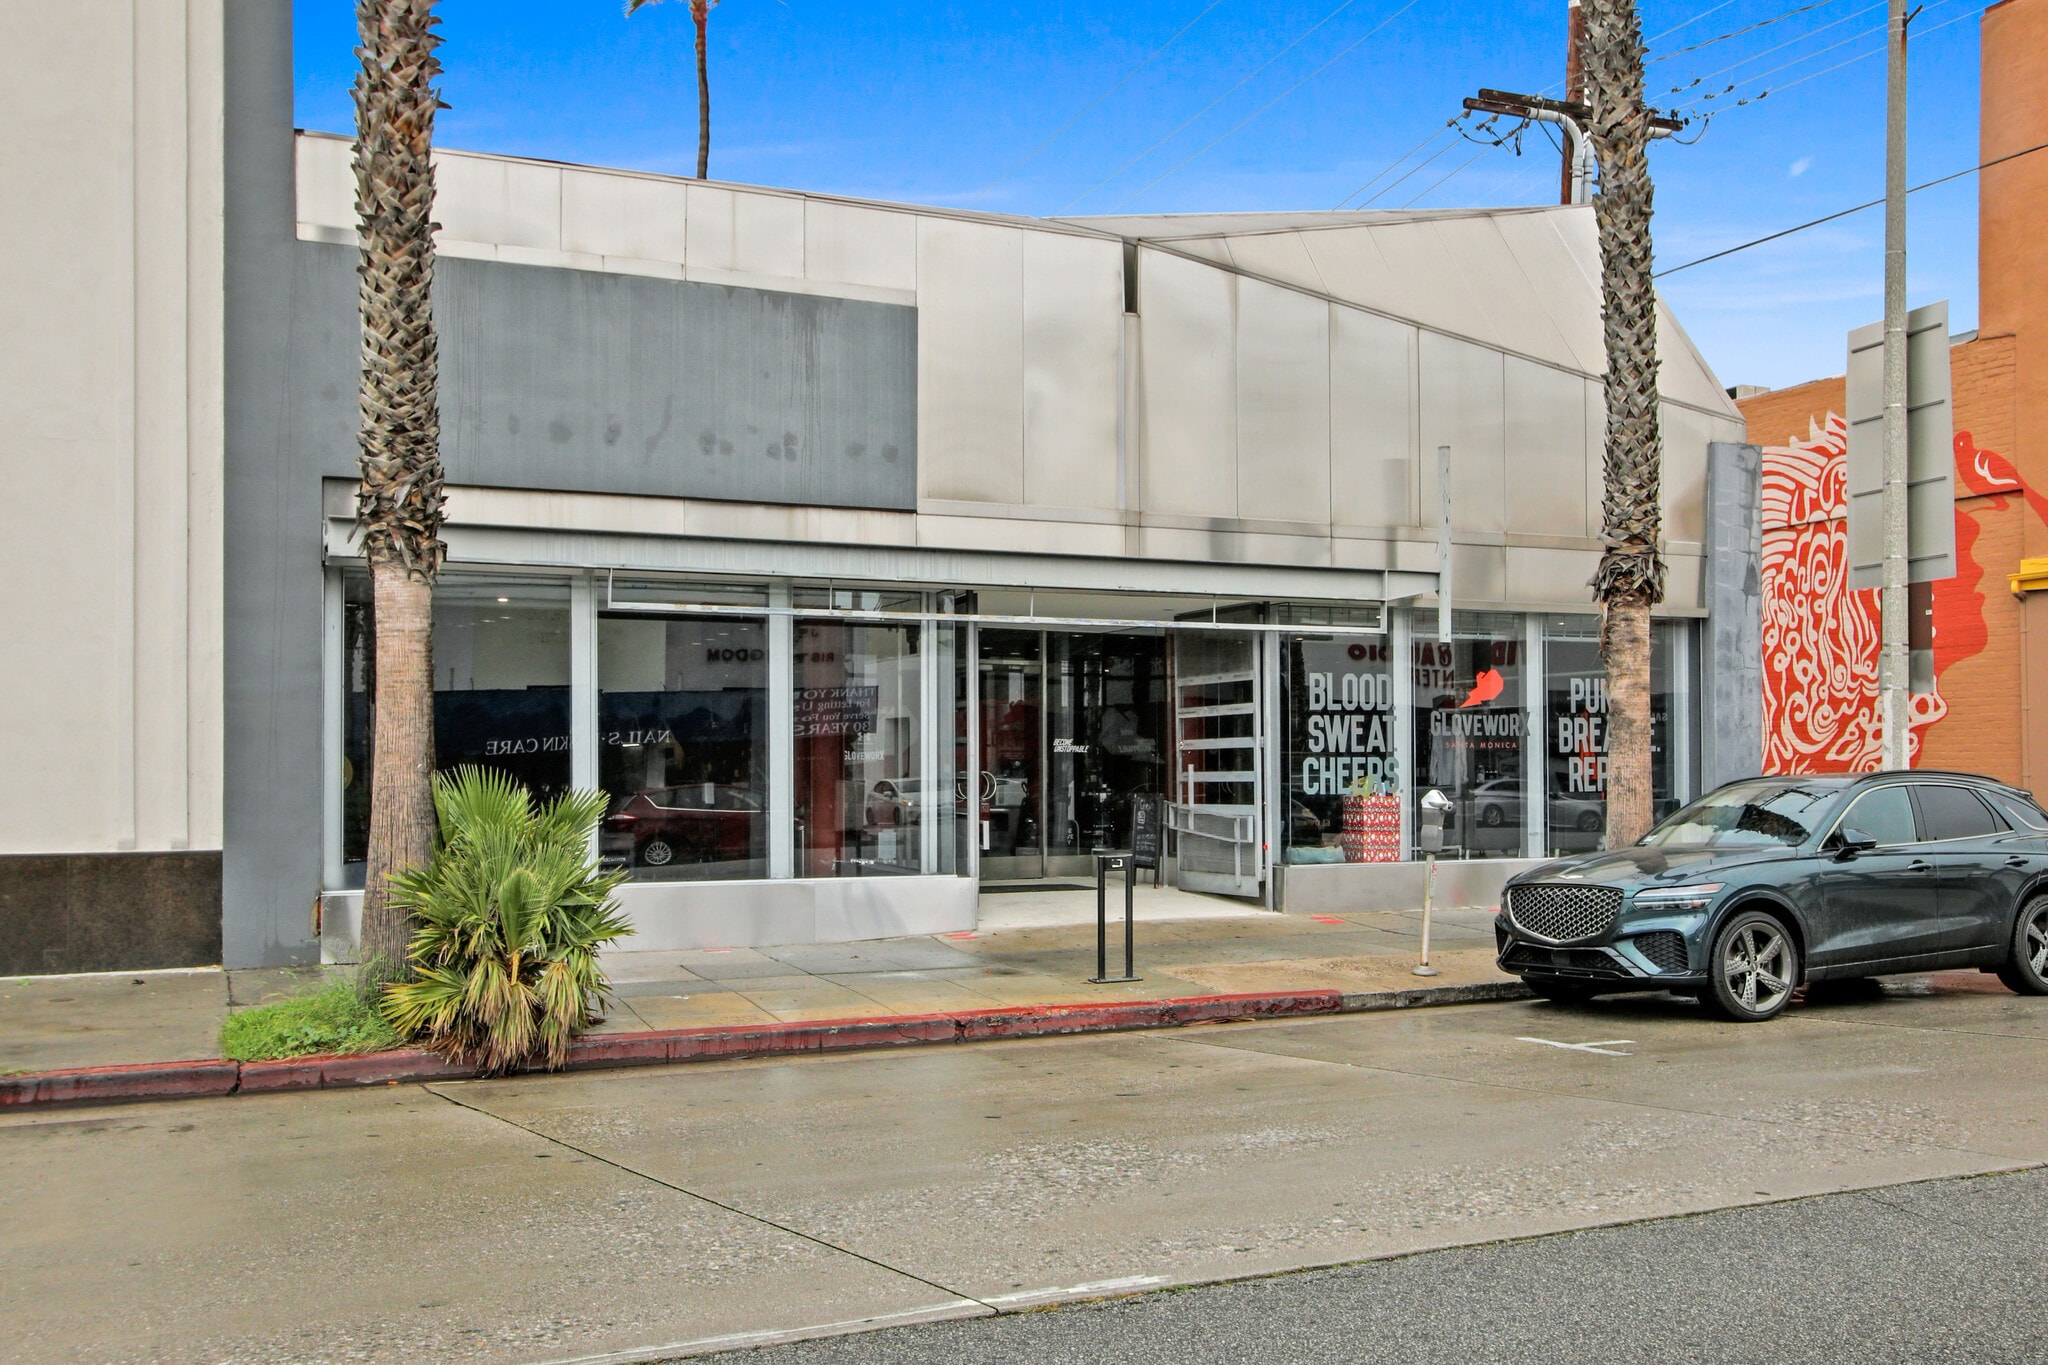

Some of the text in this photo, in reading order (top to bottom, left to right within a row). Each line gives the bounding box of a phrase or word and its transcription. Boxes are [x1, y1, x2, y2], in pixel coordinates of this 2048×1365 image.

[1570, 678, 1610, 714] PUN
[1430, 710, 1531, 737] GLOVEWORX
[1053, 745, 1089, 753] UNSTOPPABLE
